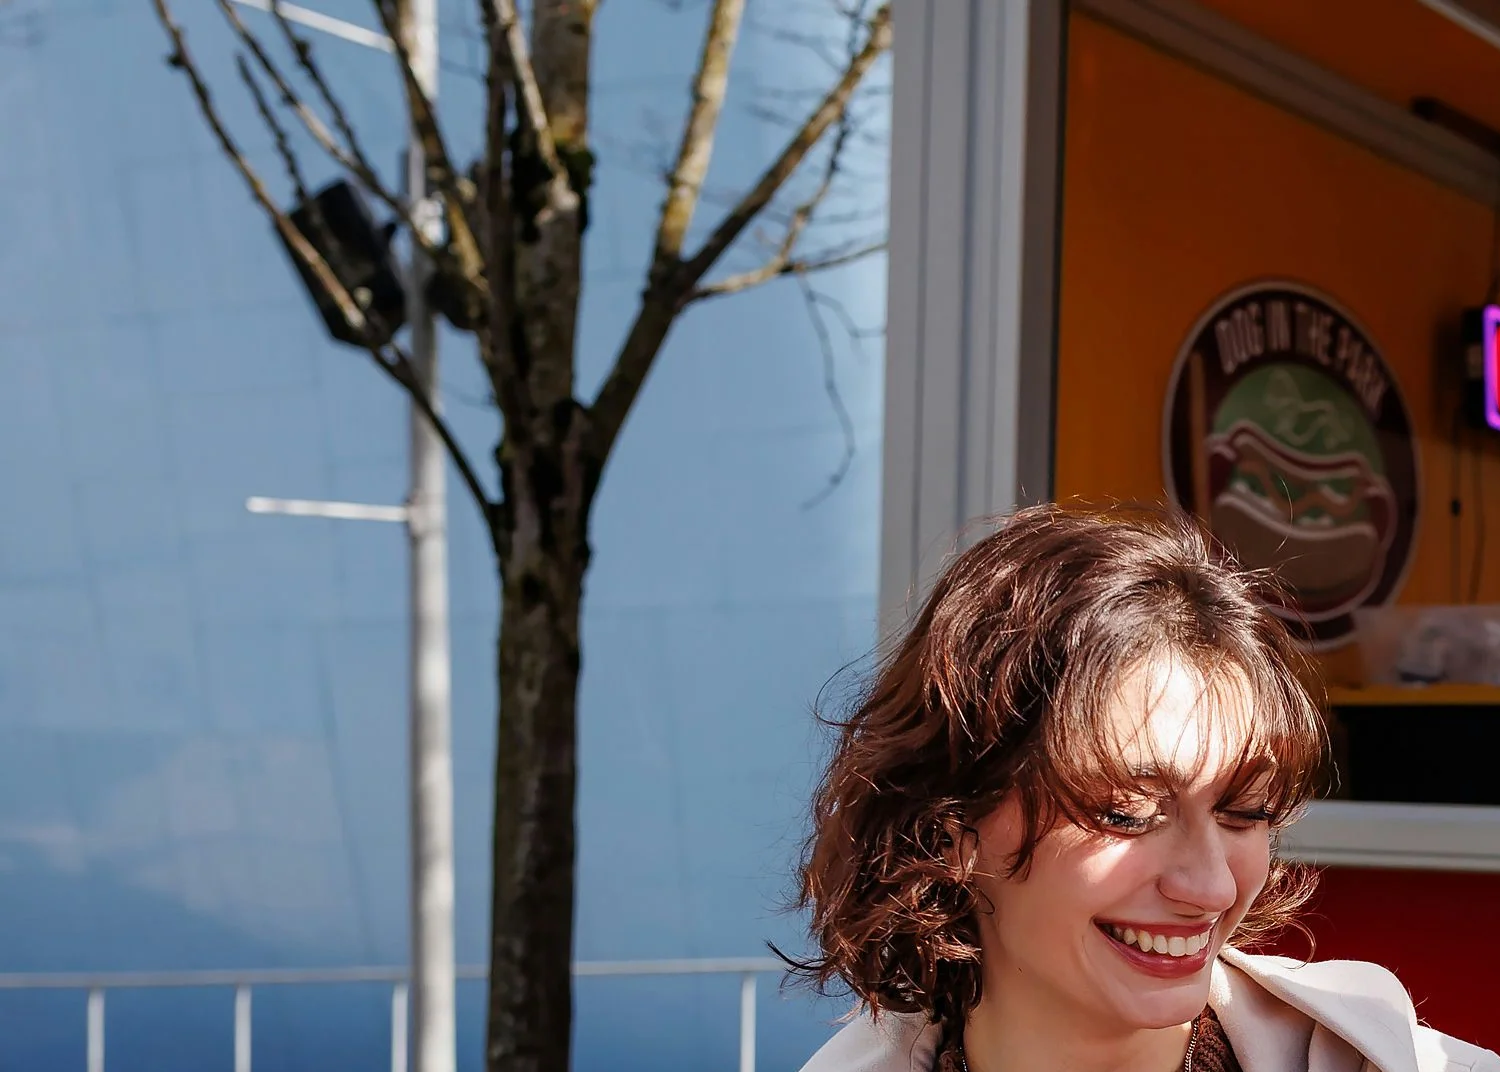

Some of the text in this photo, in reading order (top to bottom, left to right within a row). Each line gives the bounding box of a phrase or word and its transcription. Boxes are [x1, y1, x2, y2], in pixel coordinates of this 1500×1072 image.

[1214, 302, 1265, 375] DOG
[1265, 301, 1292, 352] IN
[1294, 302, 1334, 366] THE
